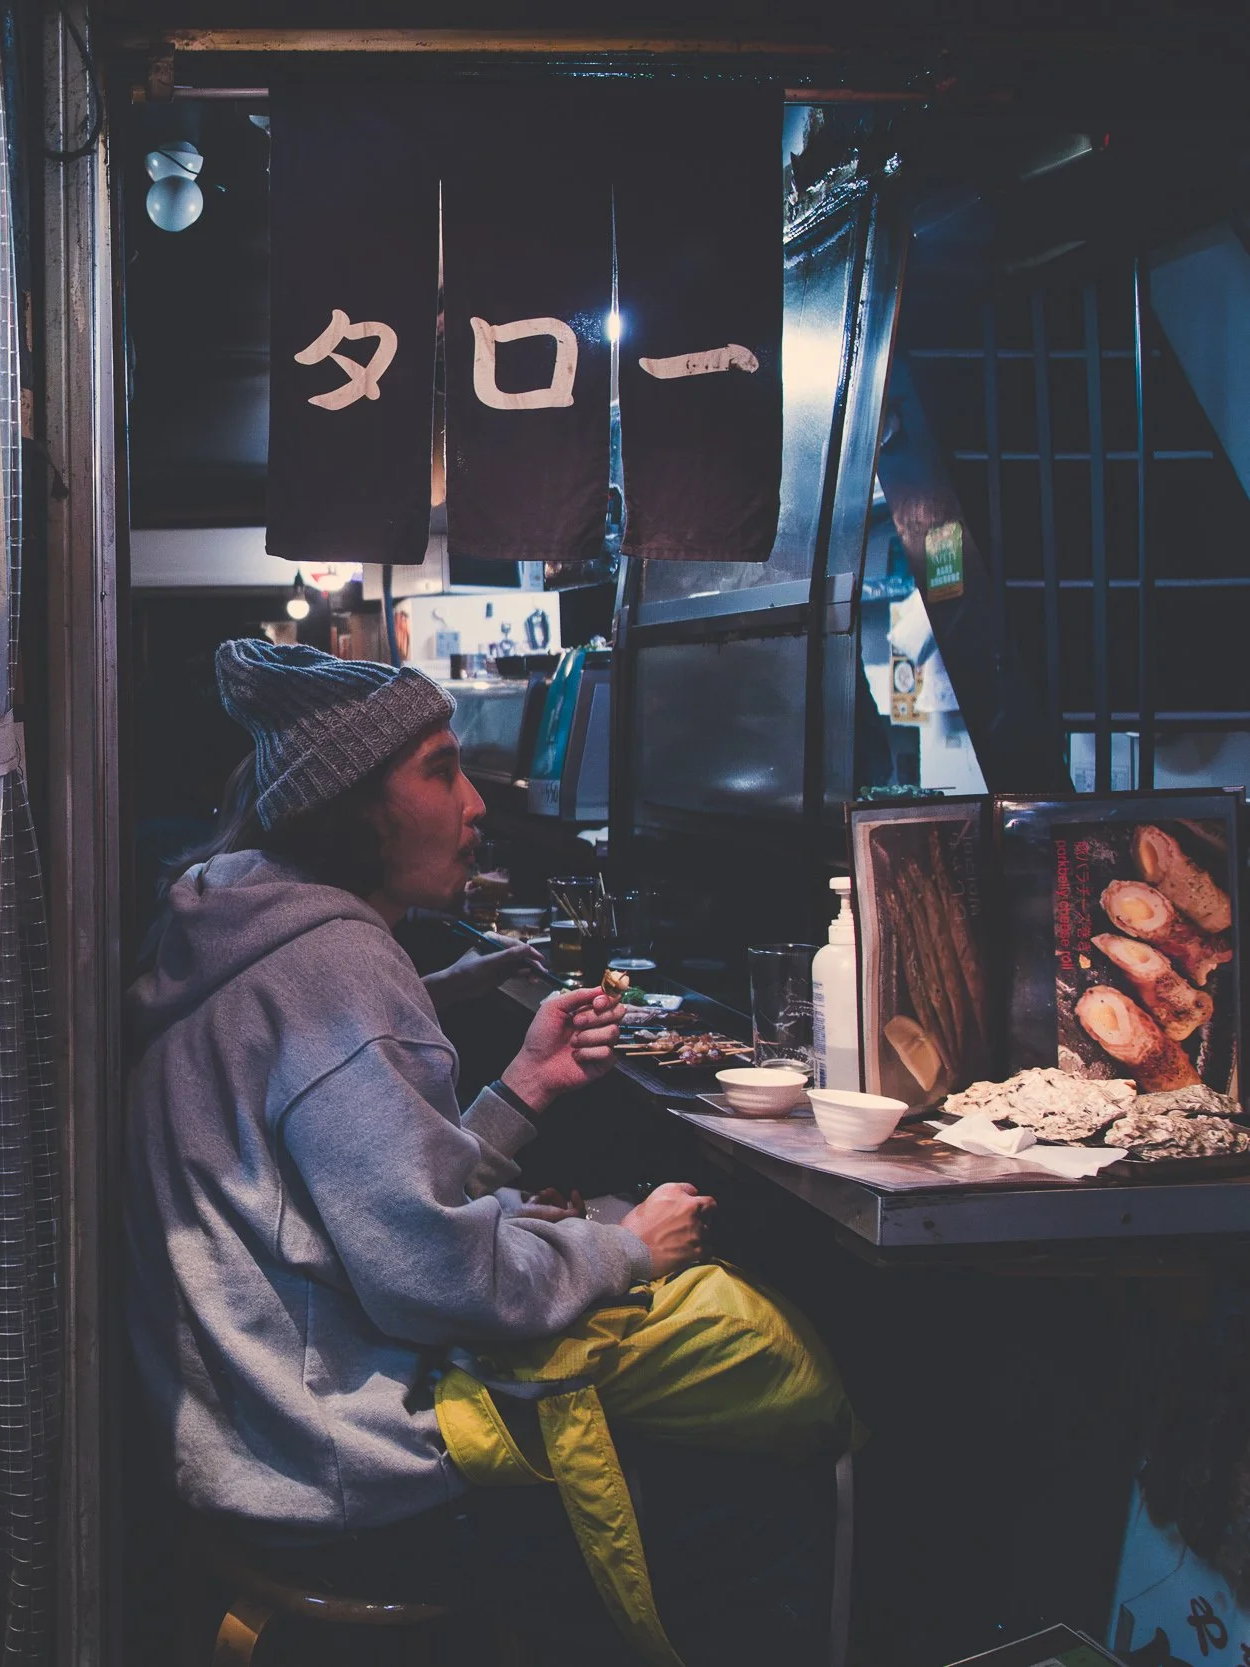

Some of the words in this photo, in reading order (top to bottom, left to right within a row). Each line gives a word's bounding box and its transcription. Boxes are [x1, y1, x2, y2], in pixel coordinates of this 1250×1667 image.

[293, 308, 759, 412] タロー
[1054, 840, 1071, 897] porkbelly
[1059, 900, 1071, 947] cheese
[1061, 951, 1075, 970] roll
